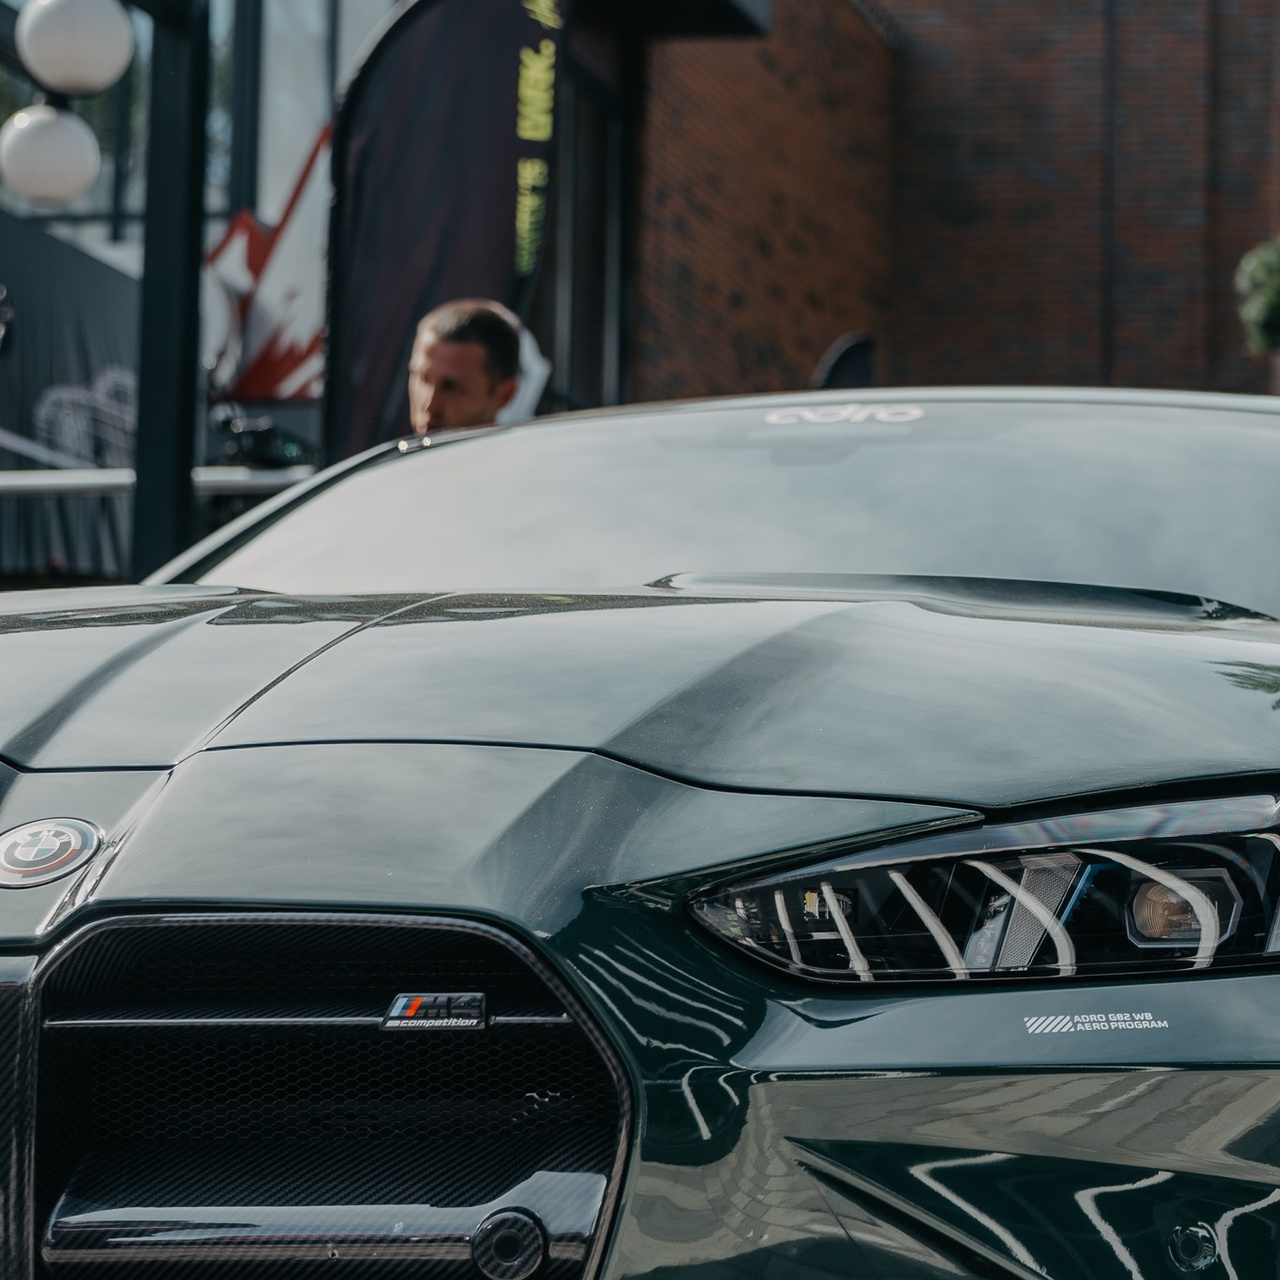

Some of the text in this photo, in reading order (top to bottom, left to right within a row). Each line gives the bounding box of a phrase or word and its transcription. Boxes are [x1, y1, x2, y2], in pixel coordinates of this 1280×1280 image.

[400, 1018, 478, 1028] competition
[1074, 1012, 1153, 1023] ADRO G82 WB
[1076, 1020, 1169, 1031] AERO PROGRAM
